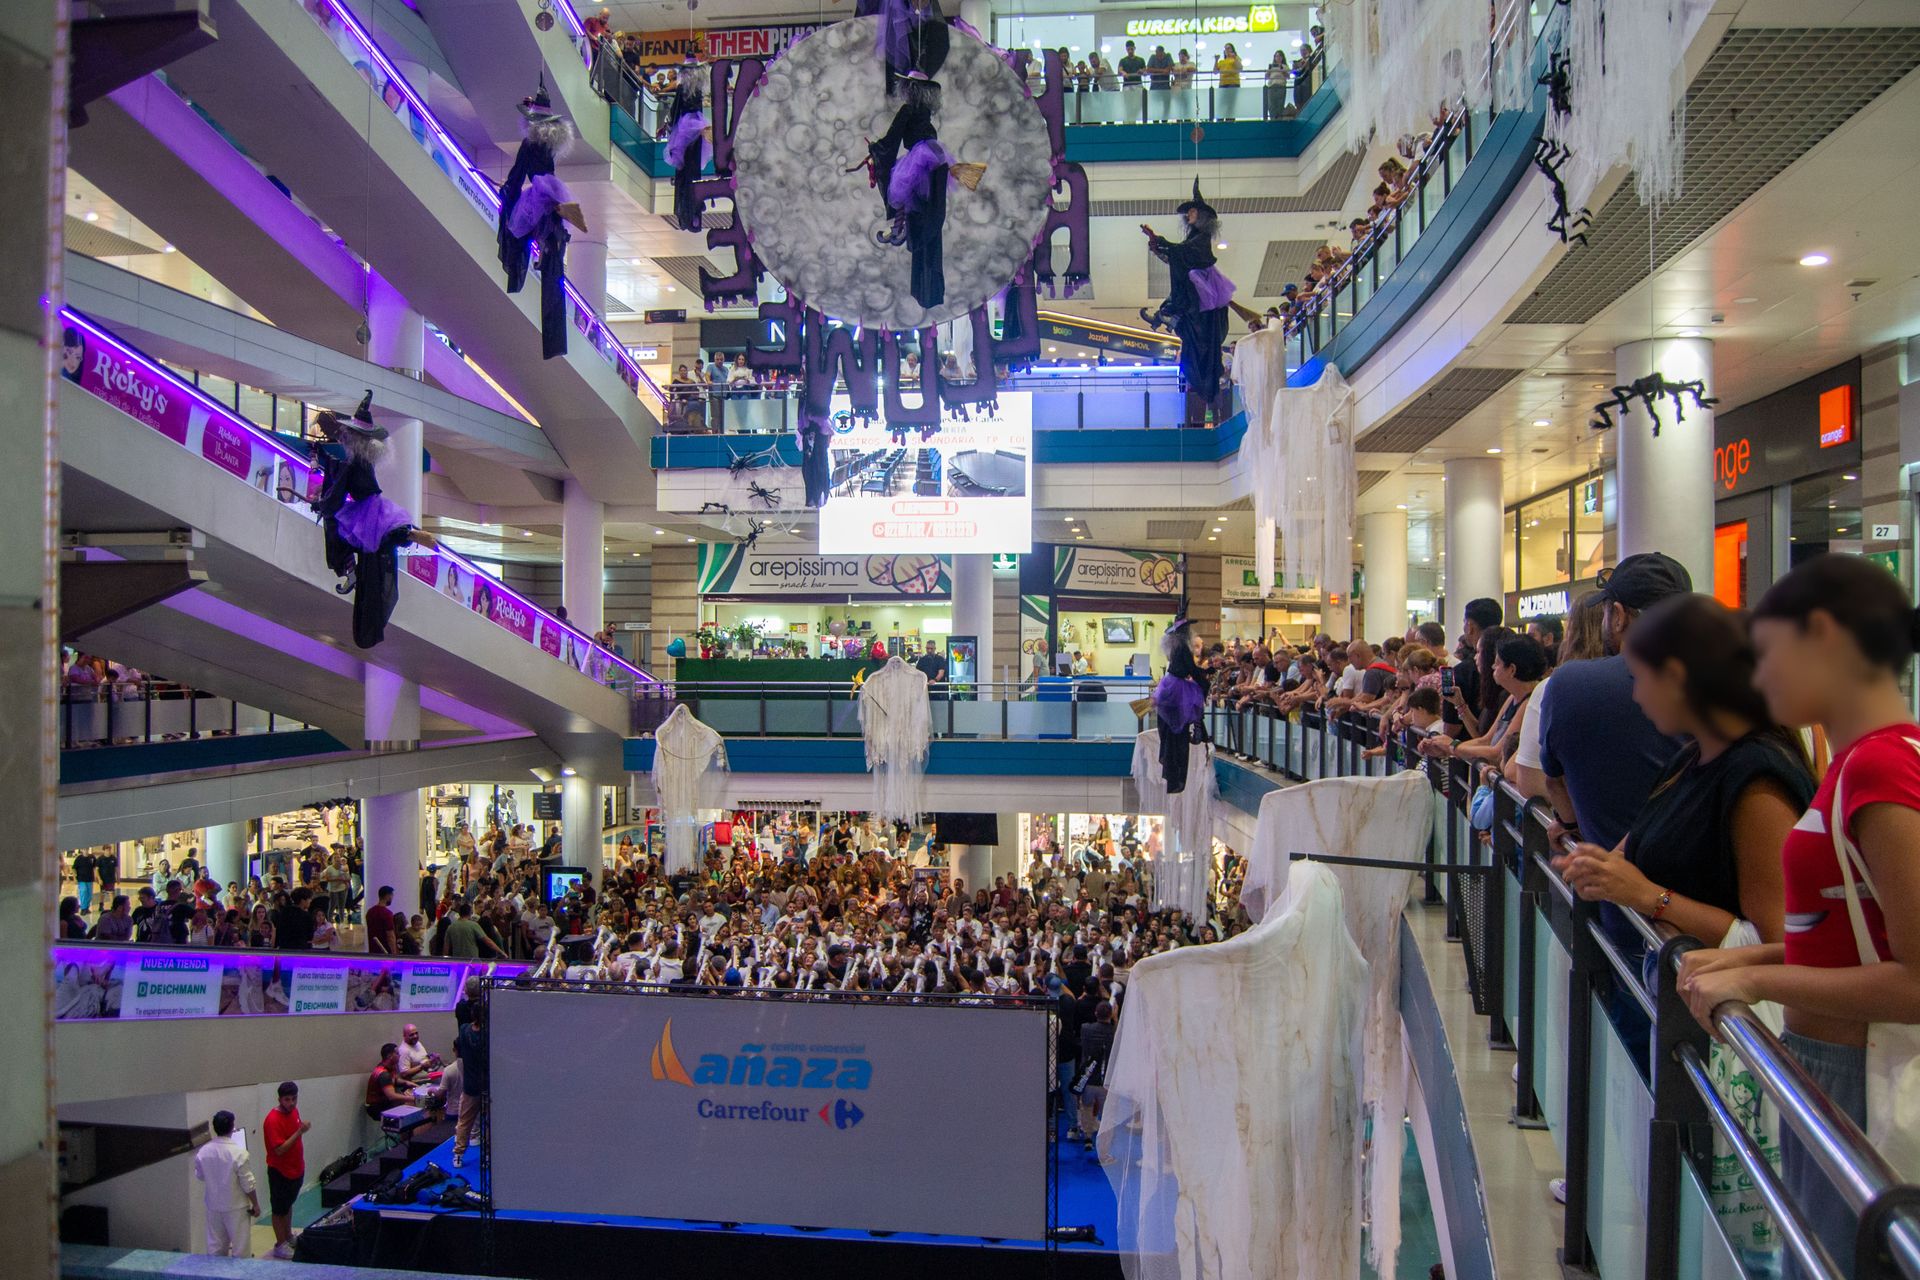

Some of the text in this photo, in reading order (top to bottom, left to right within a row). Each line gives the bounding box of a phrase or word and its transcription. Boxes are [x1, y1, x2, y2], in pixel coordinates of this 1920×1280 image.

[1126, 16, 1248, 35] EUREKAKIDS
[707, 31, 770, 56] THEN
[93, 349, 168, 414] Ricky's
[912, 435, 975, 446] SEUNDARIA
[1821, 427, 1843, 443] orange
[1714, 438, 1750, 489] nge
[1875, 526, 1889, 537] 27
[750, 557, 858, 579] arepissima
[1078, 562, 1136, 579] arepissima
[779, 577, 828, 589] snack bar
[496, 594, 526, 628] Ricky's
[1519, 591, 1567, 618] CALZEDONIA
[144, 958, 207, 970] NUEVA TIENDA
[150, 984, 207, 995] DEICHMANN
[417, 985, 449, 994] DEICHMANN
[303, 1002, 339, 1010] DEICHMANN
[693, 1043, 873, 1090] añaza
[697, 1099, 809, 1122] Carrefour
